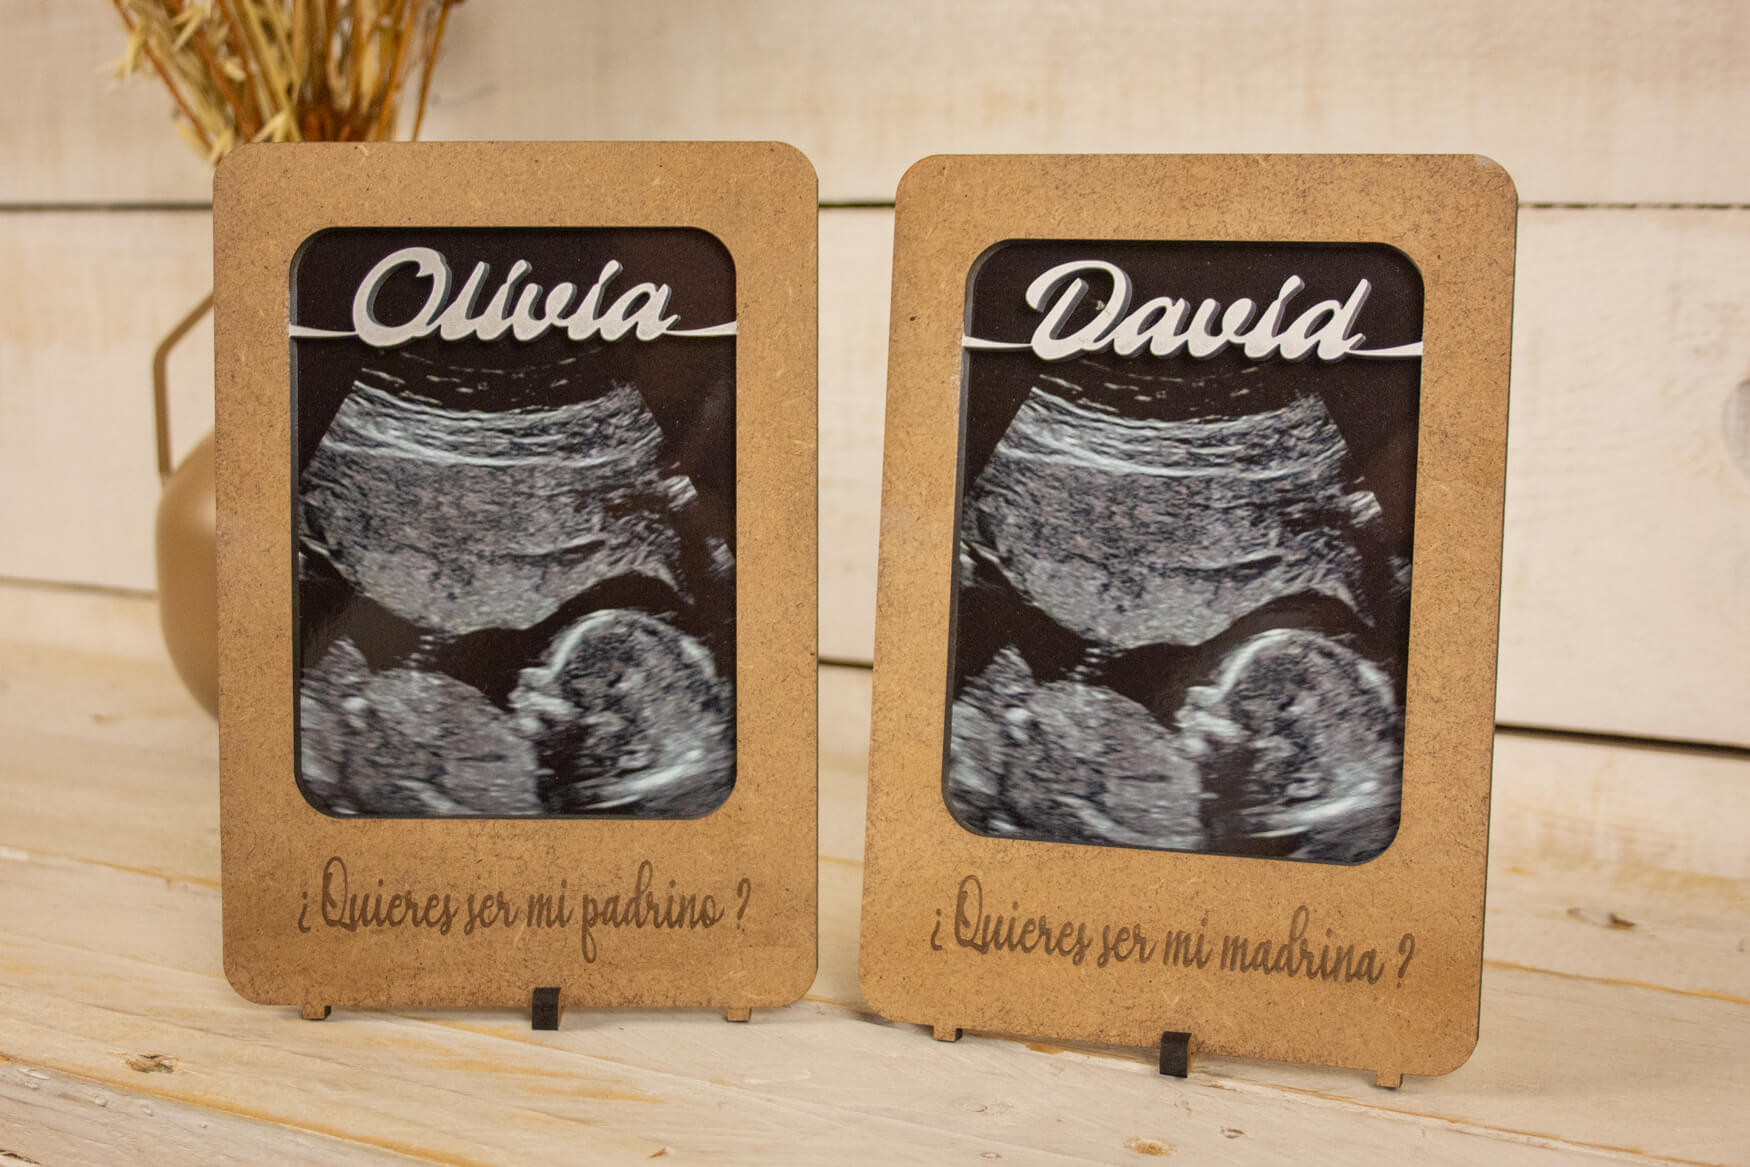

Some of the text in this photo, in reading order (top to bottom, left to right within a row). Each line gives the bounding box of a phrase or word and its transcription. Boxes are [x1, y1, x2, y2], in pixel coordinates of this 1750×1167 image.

[352, 246, 680, 347] Olivia
[1025, 260, 1372, 361] David
[463, 891, 519, 935] ser
[526, 879, 572, 929] mi
[1096, 921, 1157, 968] ser
[1163, 918, 1211, 970] mi
